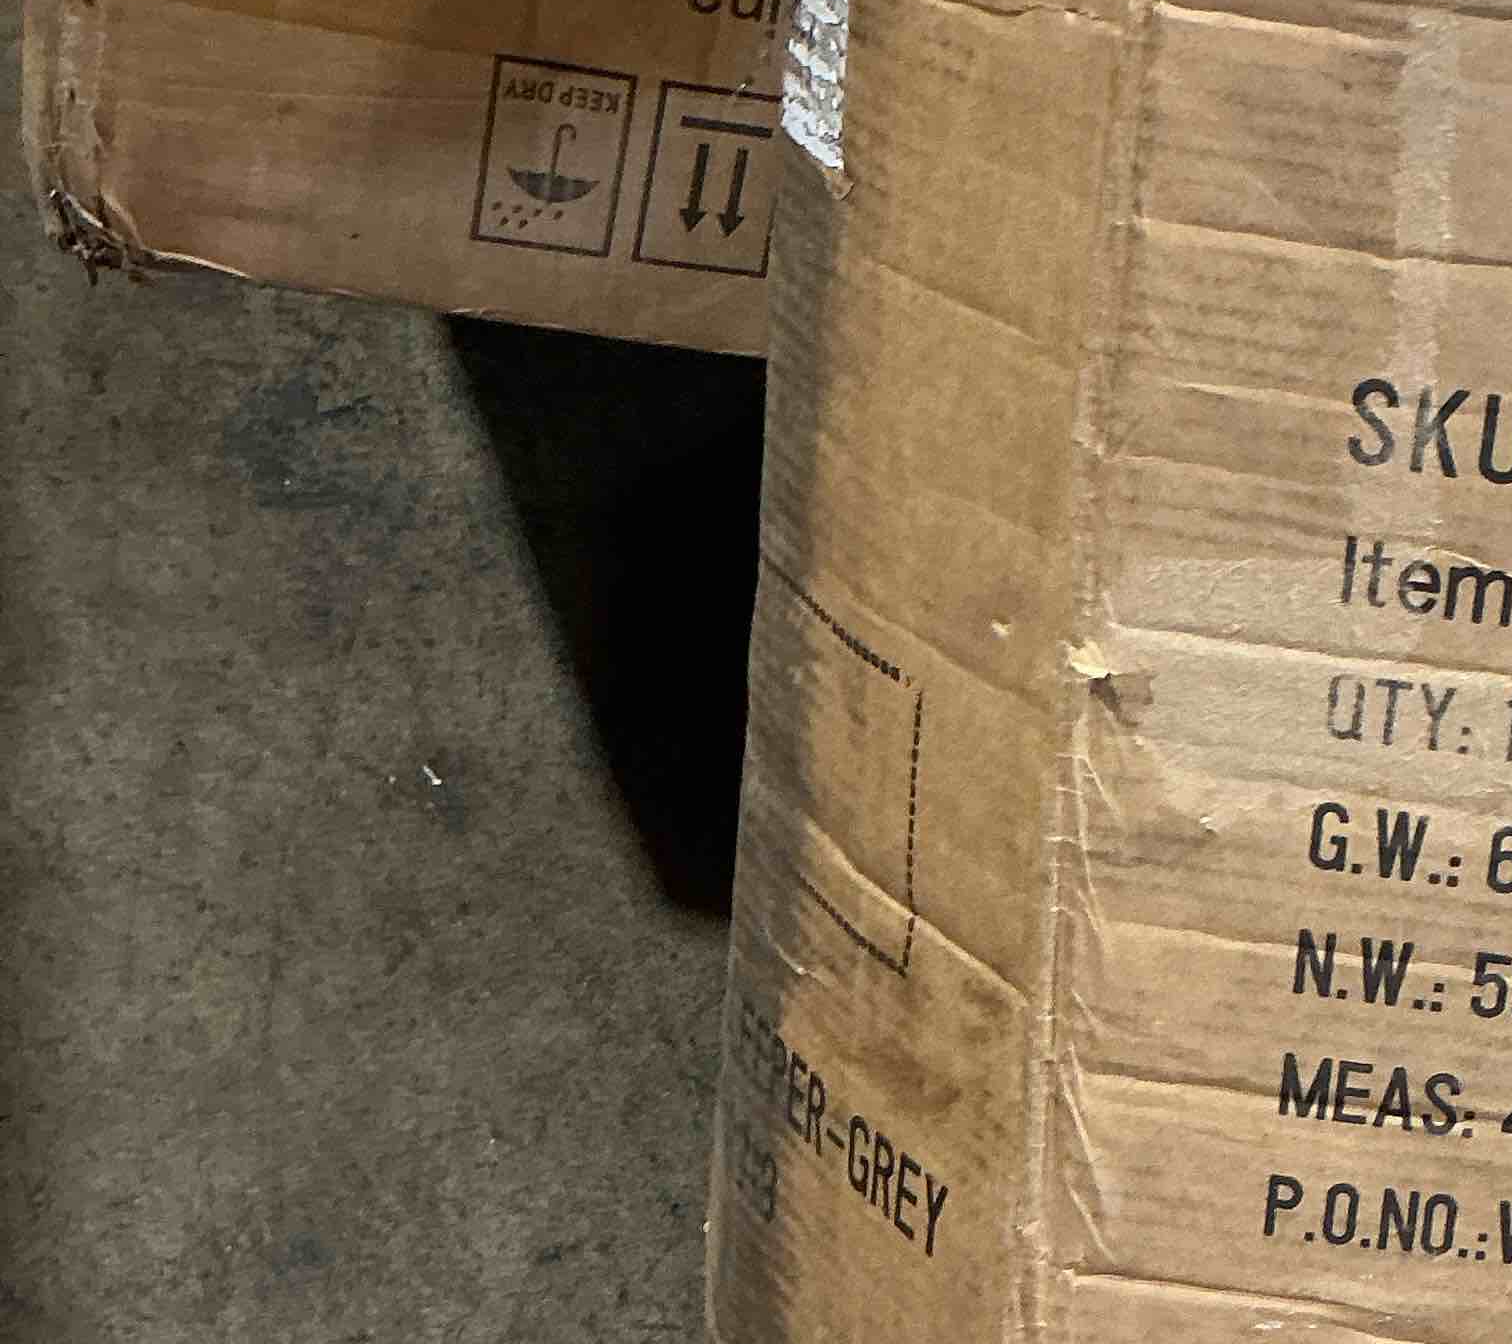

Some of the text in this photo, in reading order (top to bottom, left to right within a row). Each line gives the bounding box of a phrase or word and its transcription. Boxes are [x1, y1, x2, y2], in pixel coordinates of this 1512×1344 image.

[503, 78, 622, 114] KEEP DRY
[1327, 673, 1473, 754] QTY:
[1309, 801, 1463, 887] G.W.:
[1292, 927, 1446, 1013] N.W.:
[1278, 1052, 1476, 1139] MEAS:
